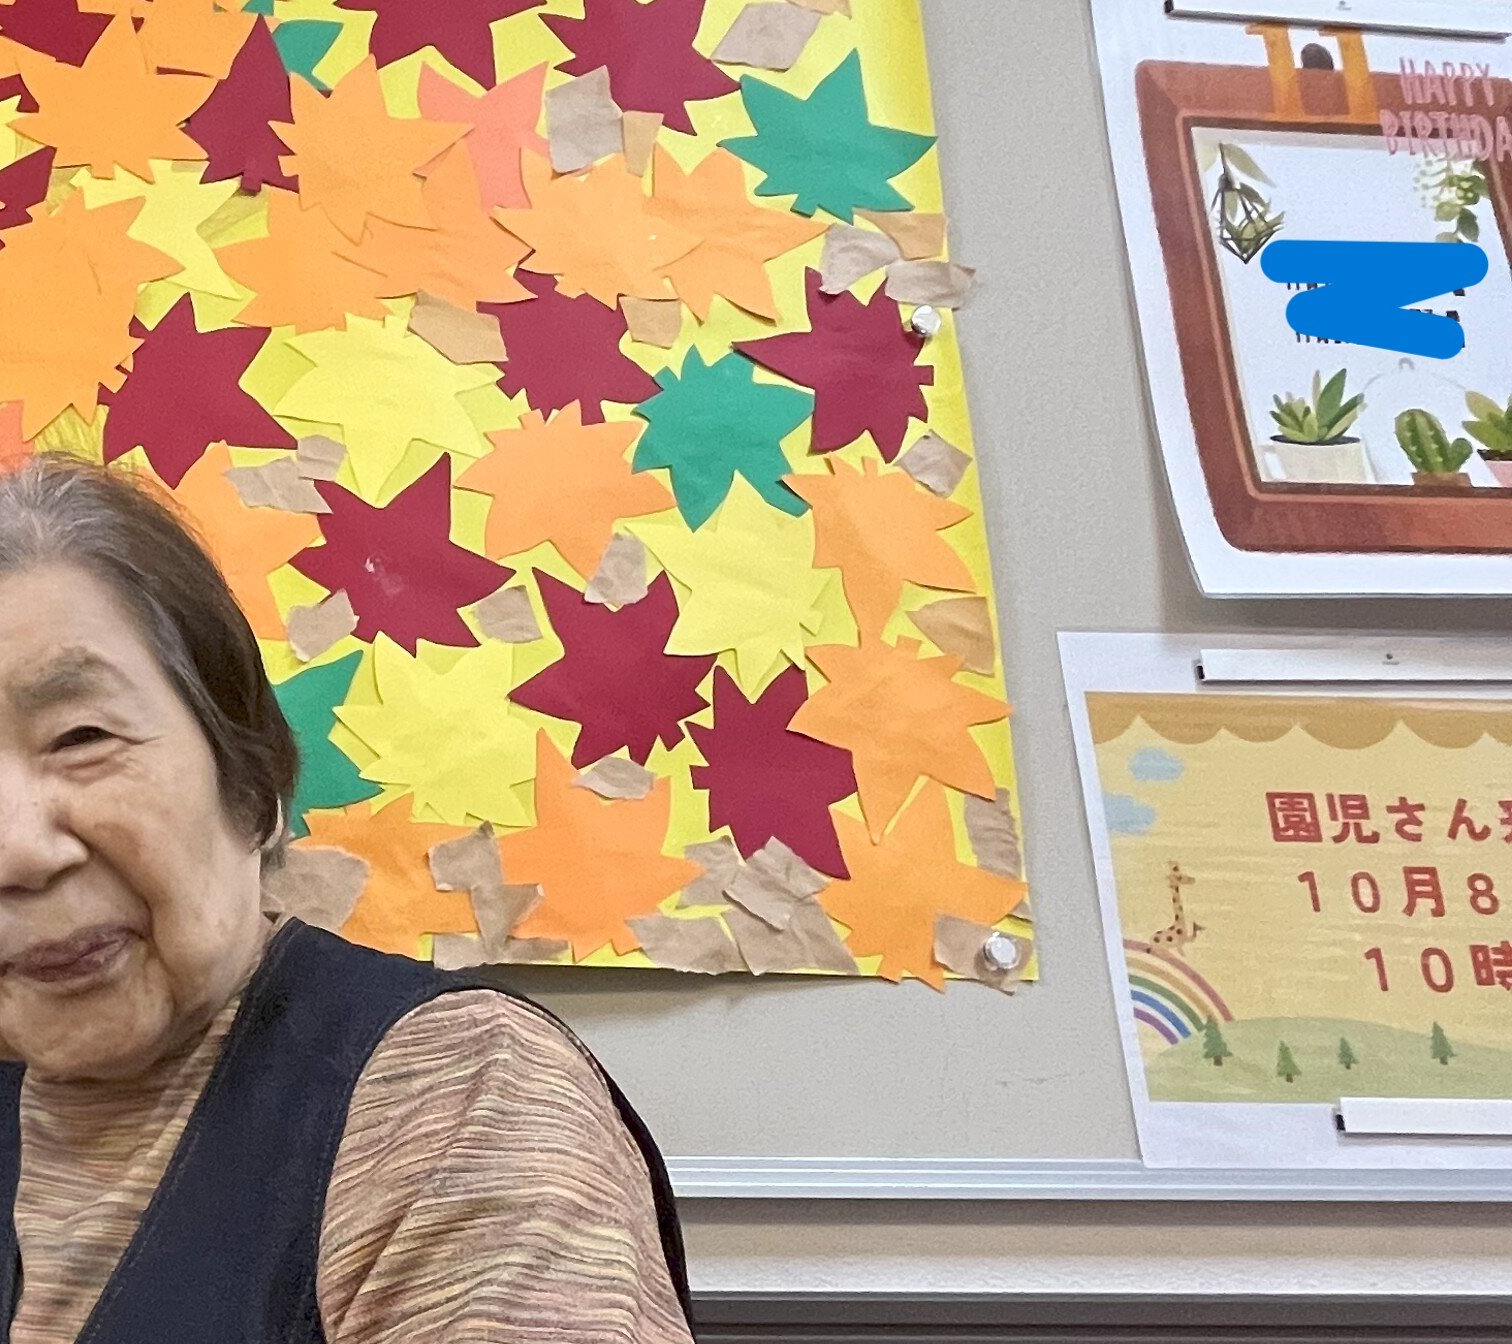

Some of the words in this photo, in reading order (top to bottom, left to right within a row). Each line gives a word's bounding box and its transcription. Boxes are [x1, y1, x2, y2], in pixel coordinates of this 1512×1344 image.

[1399, 56, 1495, 107] HAPPY
[1297, 866, 1500, 918] 10月8
[1364, 940, 1512, 993] 10時
